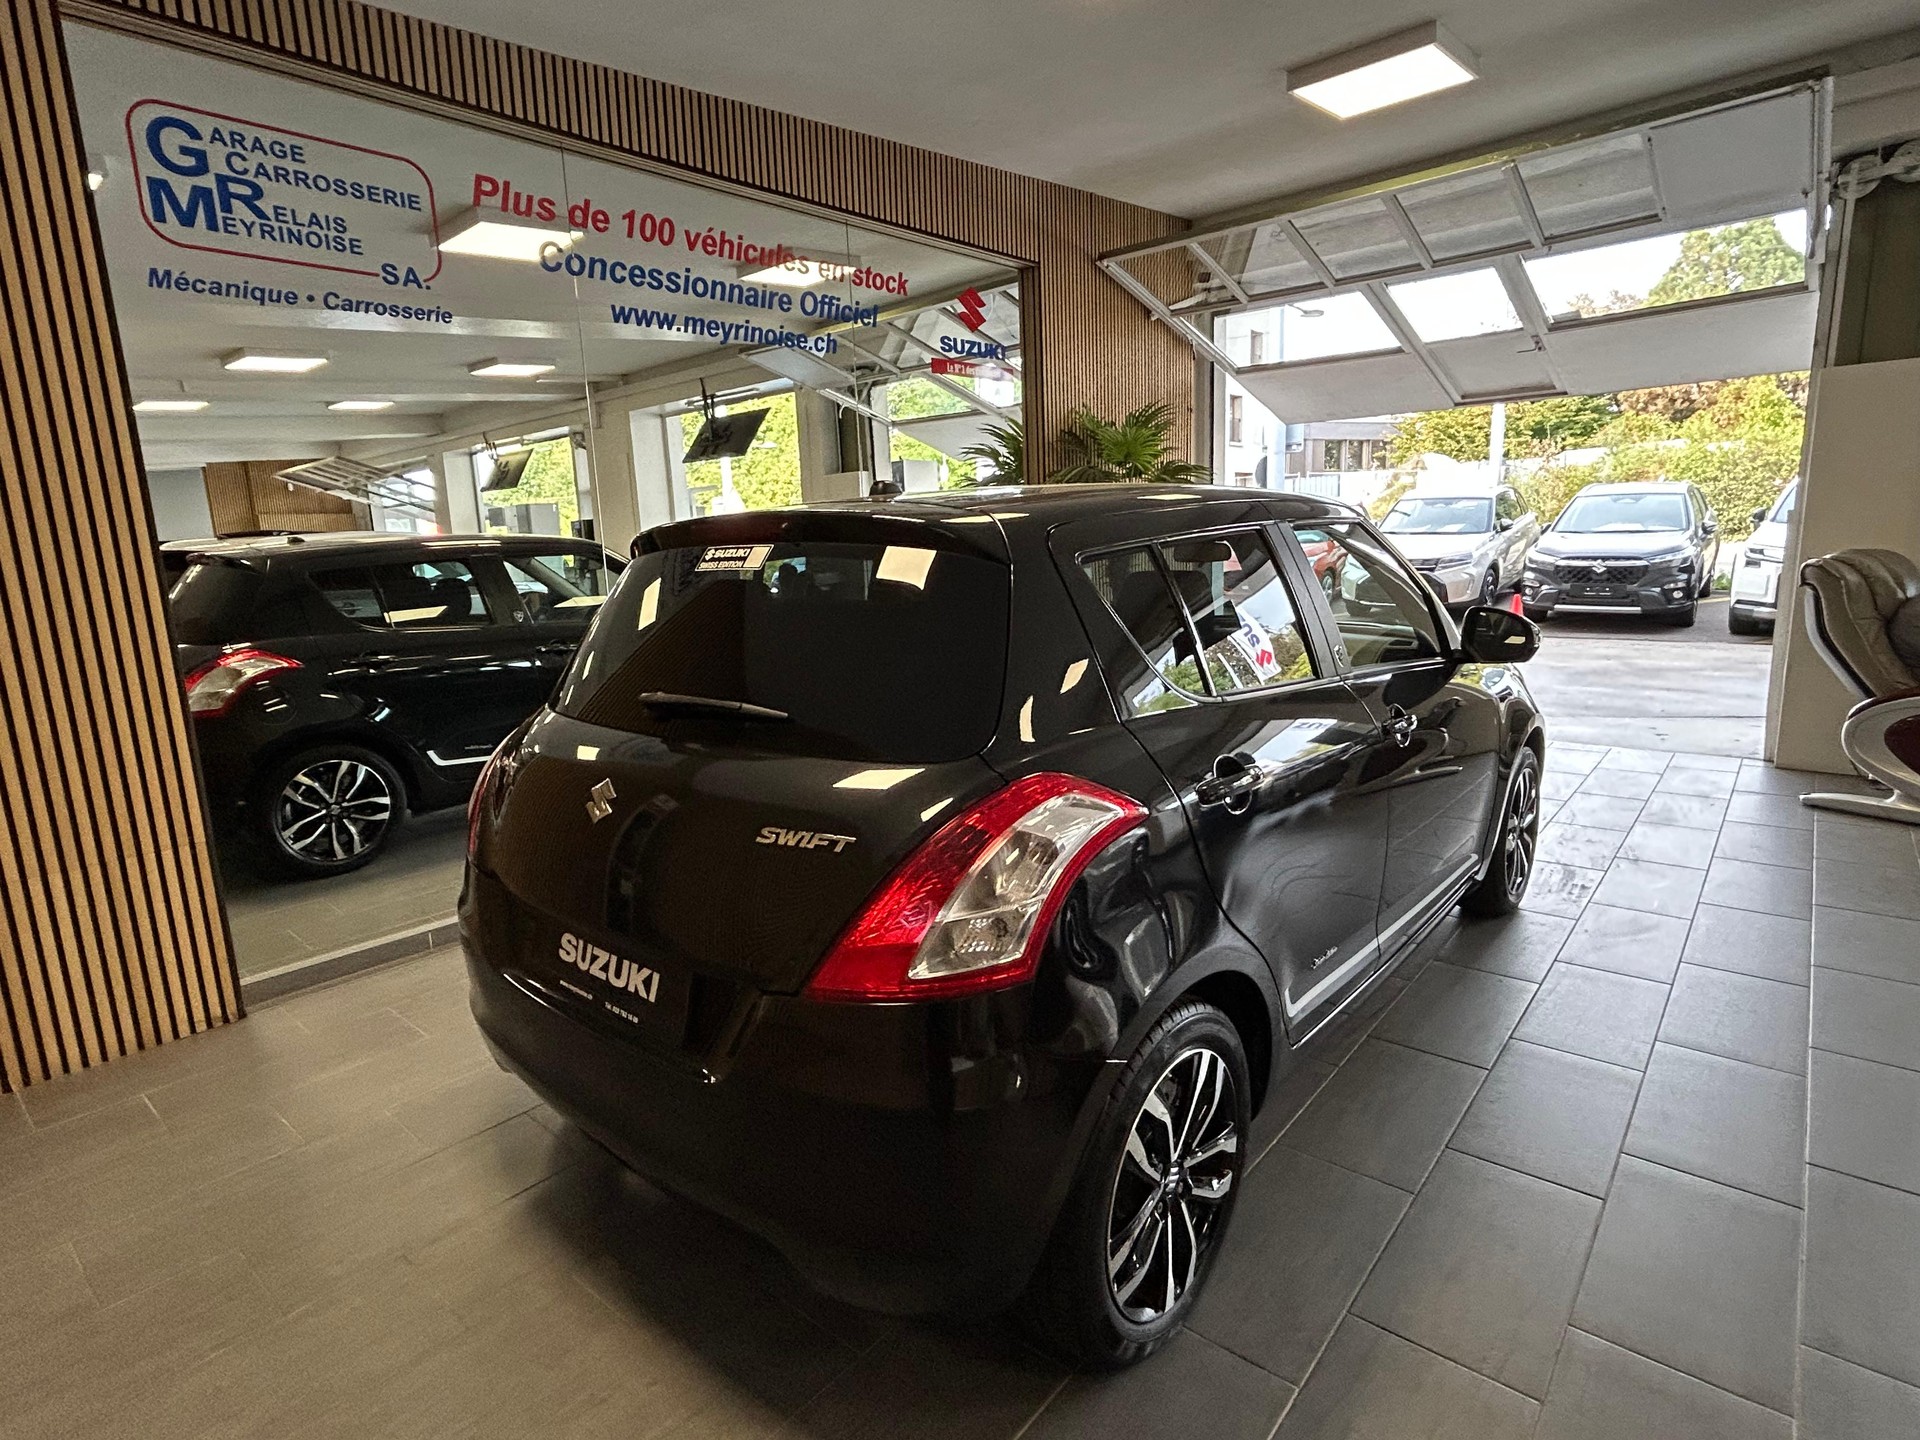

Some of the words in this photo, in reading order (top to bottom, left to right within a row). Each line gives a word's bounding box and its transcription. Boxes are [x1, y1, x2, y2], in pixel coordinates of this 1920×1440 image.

[146, 116, 306, 177] GARAGE
[214, 172, 348, 234] RELAIS
[225, 151, 422, 212] CARROSSERIE
[146, 175, 364, 255] MEYRINOISE
[473, 173, 557, 222] Plus
[568, 198, 610, 233] de
[622, 209, 675, 247] 100
[684, 226, 810, 275] véhicules
[818, 259, 845, 283] en
[852, 265, 910, 296] stock
[148, 267, 299, 307] Mécanique
[323, 290, 453, 324] Carrosserie
[381, 262, 432, 290] SA.
[539, 241, 793, 313] Concessionnaire
[800, 290, 880, 328] Officiel
[610, 304, 838, 354] www.meyrinoise.ch
[940, 335, 1006, 361] SUZUKI
[714, 548, 751, 558] SUZUKI
[756, 826, 857, 853] SWIFT
[558, 932, 660, 1003] SUZUKI
